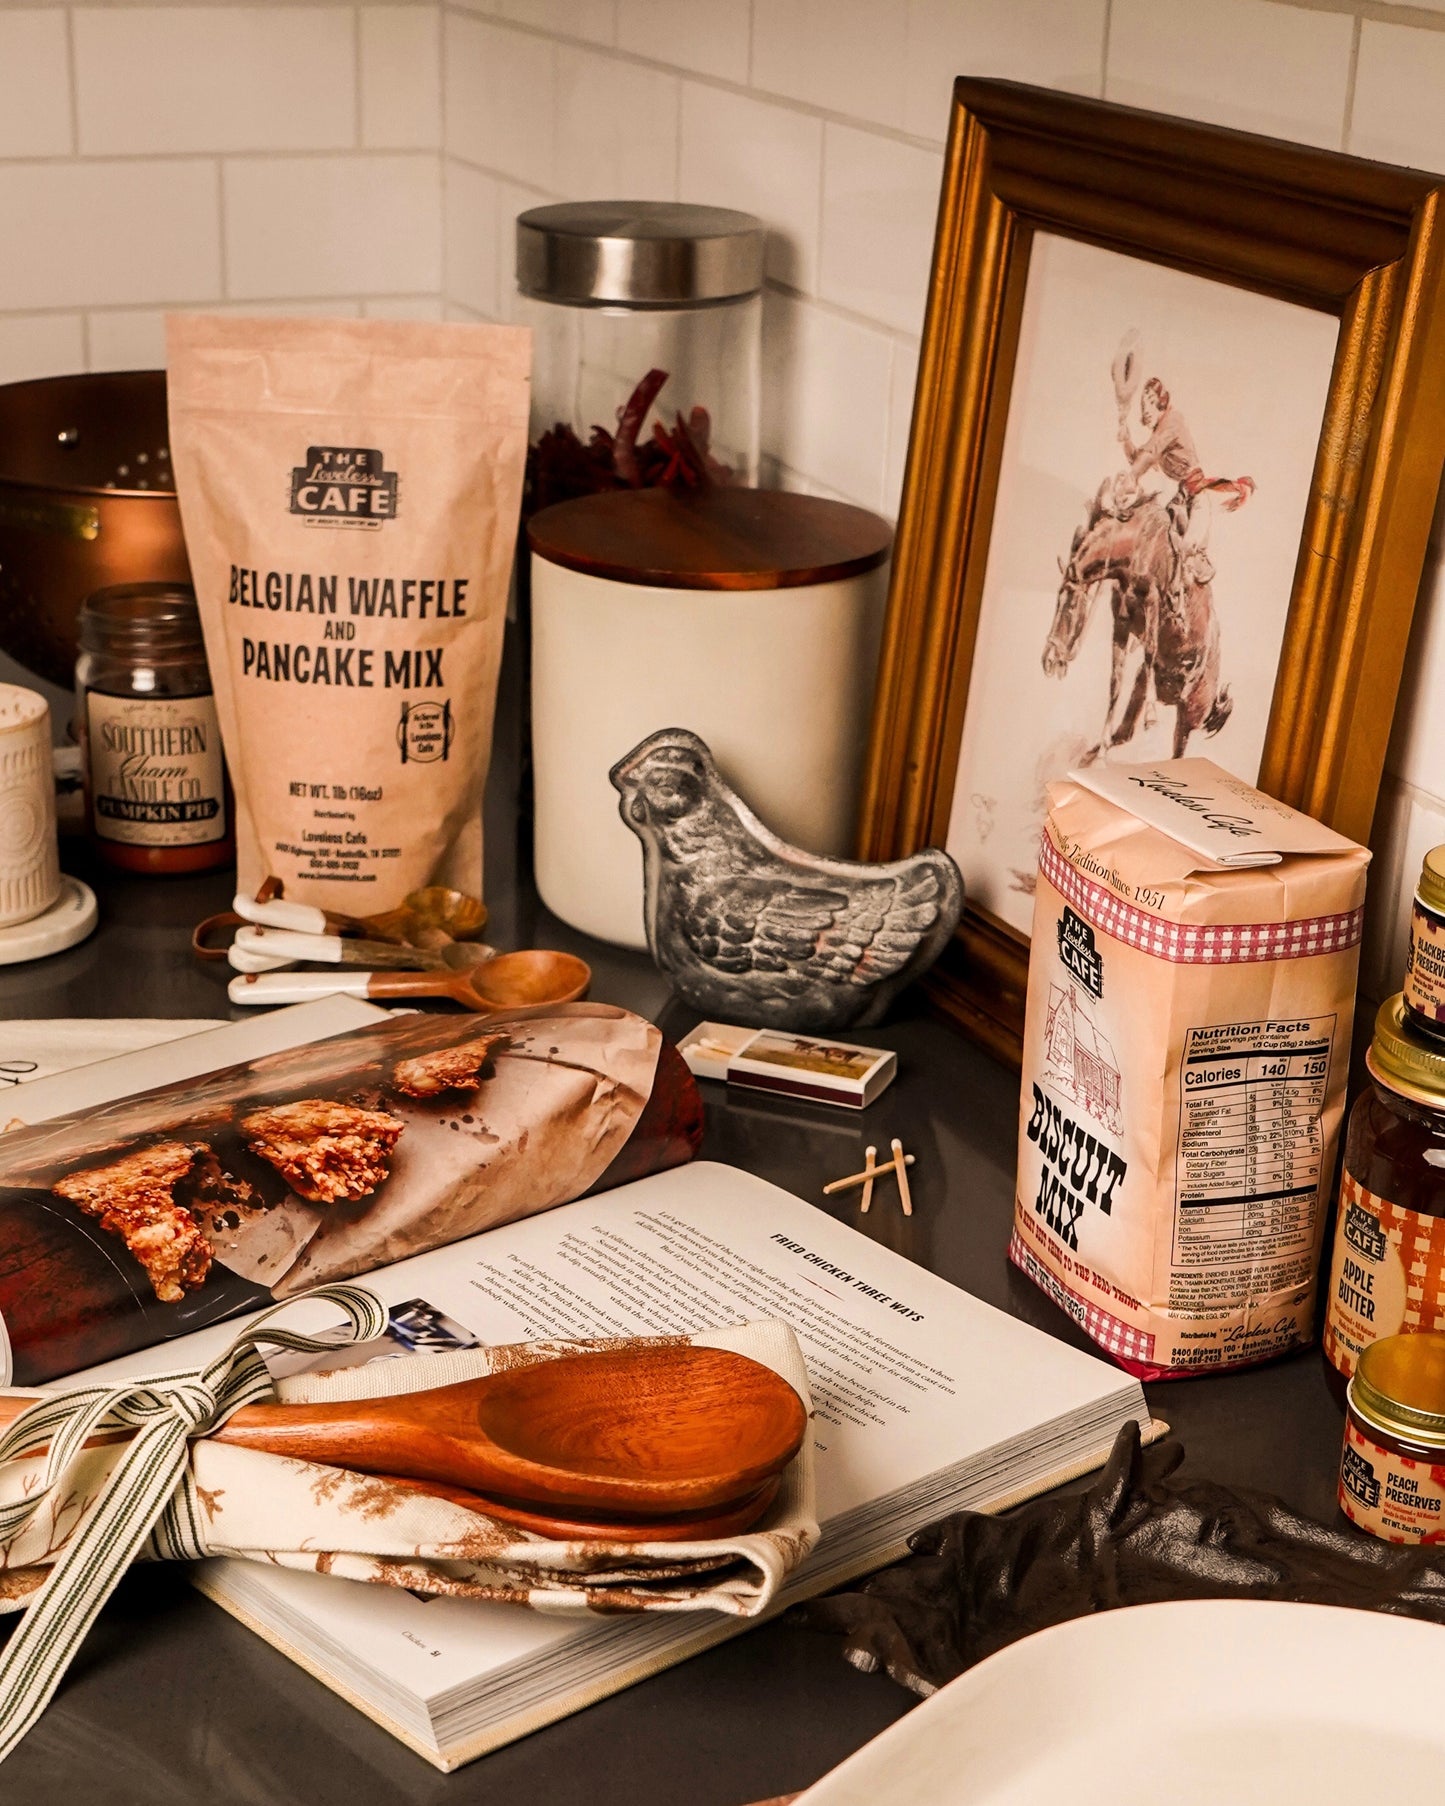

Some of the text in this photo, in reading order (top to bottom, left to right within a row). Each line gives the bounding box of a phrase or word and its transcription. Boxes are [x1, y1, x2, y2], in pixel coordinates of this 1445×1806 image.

[321, 451, 367, 466] THE
[305, 463, 384, 486] Loveless
[297, 486, 390, 513] CAFE
[229, 564, 469, 618] BELGIAN WAFFLE
[323, 620, 355, 641] AND
[243, 637, 444, 688] PANCAKE MIX
[102, 721, 207, 756] SOUTHERN
[120, 753, 188, 778] Charm
[289, 782, 307, 797] NET
[101, 799, 214, 821] PUMPKIN PIE
[1128, 777, 1215, 812] Loveless
[1202, 814, 1262, 837] Cafe
[302, 829, 367, 845] Loveless Cafe
[1110, 869, 1131, 896] Since
[1134, 886, 1166, 910] 1951
[1069, 915, 1088, 940] THE
[1063, 923, 1095, 963] Loveless
[1061, 940, 1099, 991] CAFE
[1191, 1039, 1209, 1047] About
[1220, 1035, 1247, 1045] servings
[1249, 1035, 1260, 1043] per
[1192, 1022, 1310, 1040] Nutrition Facts
[1189, 1047, 1215, 1056] Serving
[1264, 1041, 1278, 1050] Cup
[1280, 1040, 1298, 1049] (35g)
[1304, 1037, 1329, 1047] biscuits
[1185, 1061, 1326, 1085] Calories 140 150
[1189, 1110, 1220, 1118] Saturated
[1182, 1130, 1222, 1138] Cholesterol
[1284, 1119, 1297, 1127] 5mg
[1026, 1082, 1128, 1216] BISCUIT
[1182, 1140, 1208, 1148] Sodium
[1182, 1148, 1245, 1159] Total Carbohydrate
[1186, 1160, 1209, 1170] Dietary
[1204, 1170, 1226, 1179] Sugars
[1035, 1164, 1085, 1252] MIX
[1180, 1192, 1205, 1200] Protein
[1178, 1216, 1205, 1224] Calcium
[1180, 1208, 1204, 1216] Vitamin
[1355, 1209, 1374, 1225] THE
[1178, 1234, 1210, 1242] Potassium
[1346, 1224, 1381, 1256] CAFE
[733, 1254, 749, 1265] way
[748, 1262, 767, 1278] right
[770, 1234, 924, 1322] FRIED CHICKEN THREE WAYS
[1343, 1257, 1375, 1295] APPLE
[1063, 1255, 1073, 1272] TO
[1073, 1261, 1090, 1282] THE
[1092, 1271, 1112, 1295] REAL
[1112, 1285, 1142, 1311] THING
[1338, 1278, 1375, 1322] BUTTER
[1223, 1323, 1271, 1342] Loveless
[1273, 1317, 1297, 1333] Cafe
[789, 1301, 956, 1396] golden delicious fried chicken from cast-iron
[799, 1317, 929, 1393] And please invite us over for dinner.
[803, 1333, 874, 1375] should do the trick.
[824, 1309, 956, 1383] are one of the fortunate ones whose
[1172, 1348, 1191, 1356] 8400
[1193, 1346, 1222, 1358] Highway
[1223, 1344, 1236, 1353] 100
[804, 1353, 911, 1414] chicken has been fried in the
[816, 1374, 877, 1408] salt water helps
[810, 1382, 887, 1427] extra-moist chicken.
[822, 1400, 868, 1428] Next comes
[832, 1418, 842, 1426] to
[1349, 1450, 1366, 1470] THE
[1342, 1466, 1375, 1503] CAFE
[1387, 1472, 1418, 1493] PEACH
[1385, 1487, 1441, 1511] PRESERVES
[1382, 1517, 1392, 1526] NET
[1402, 1523, 1412, 1533] 2oz
[1412, 1526, 1427, 1537] (57g)
